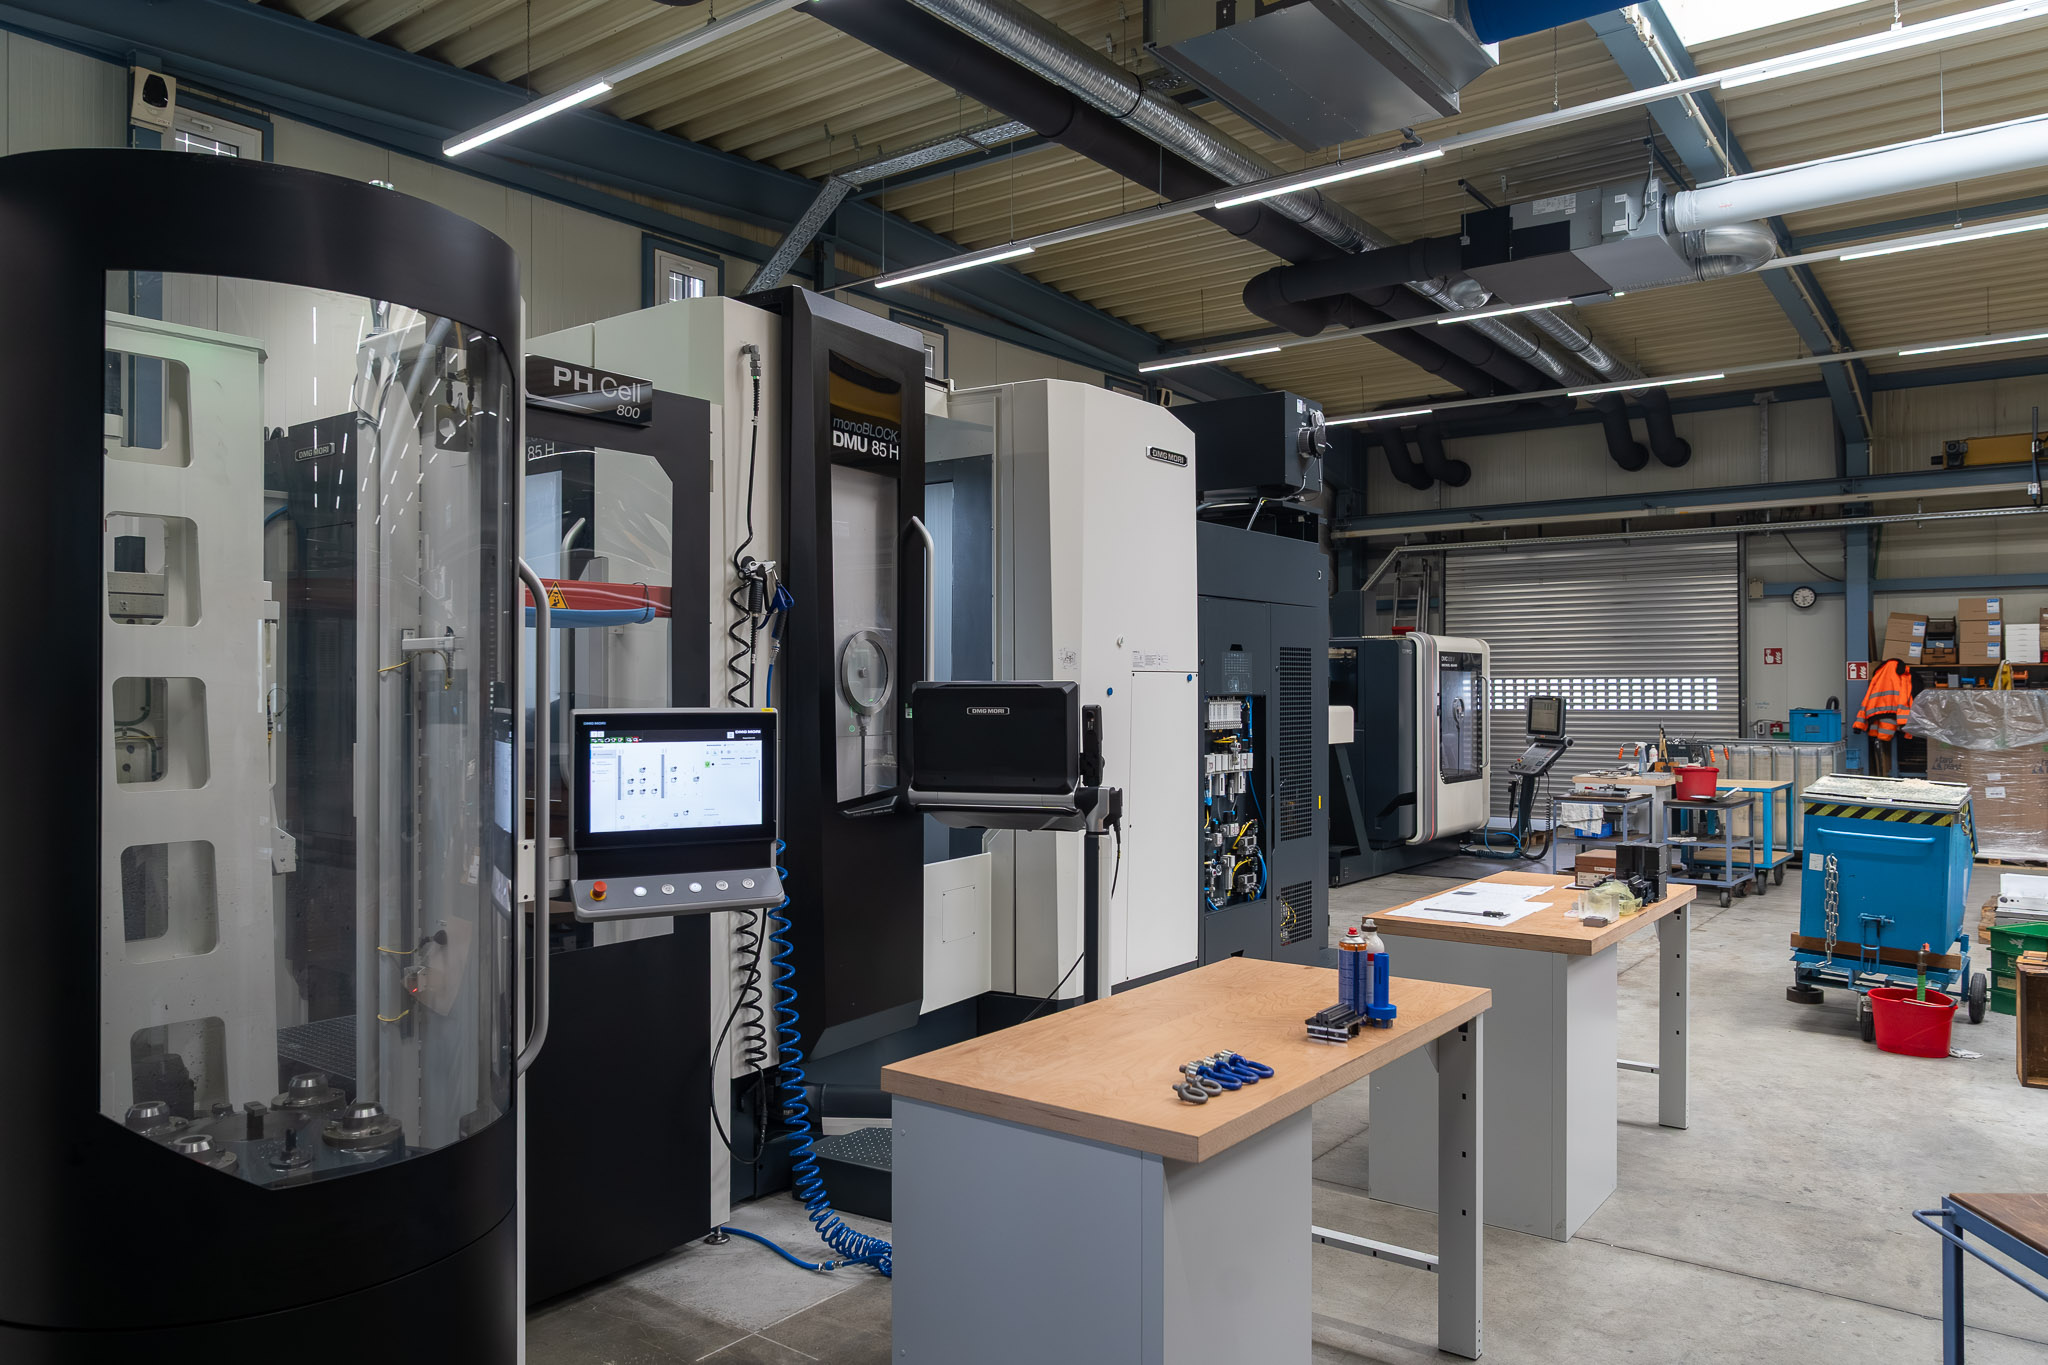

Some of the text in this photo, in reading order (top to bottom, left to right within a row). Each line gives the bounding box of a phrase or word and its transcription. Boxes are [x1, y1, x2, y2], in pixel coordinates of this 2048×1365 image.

[553, 365, 641, 404] PH Cell
[616, 404, 641, 419] 800
[833, 417, 899, 443] monoBLOCK
[527, 441, 555, 460] 85 H
[832, 430, 899, 461] DMU 85 H
[1152, 449, 1184, 464] DMG MORI
